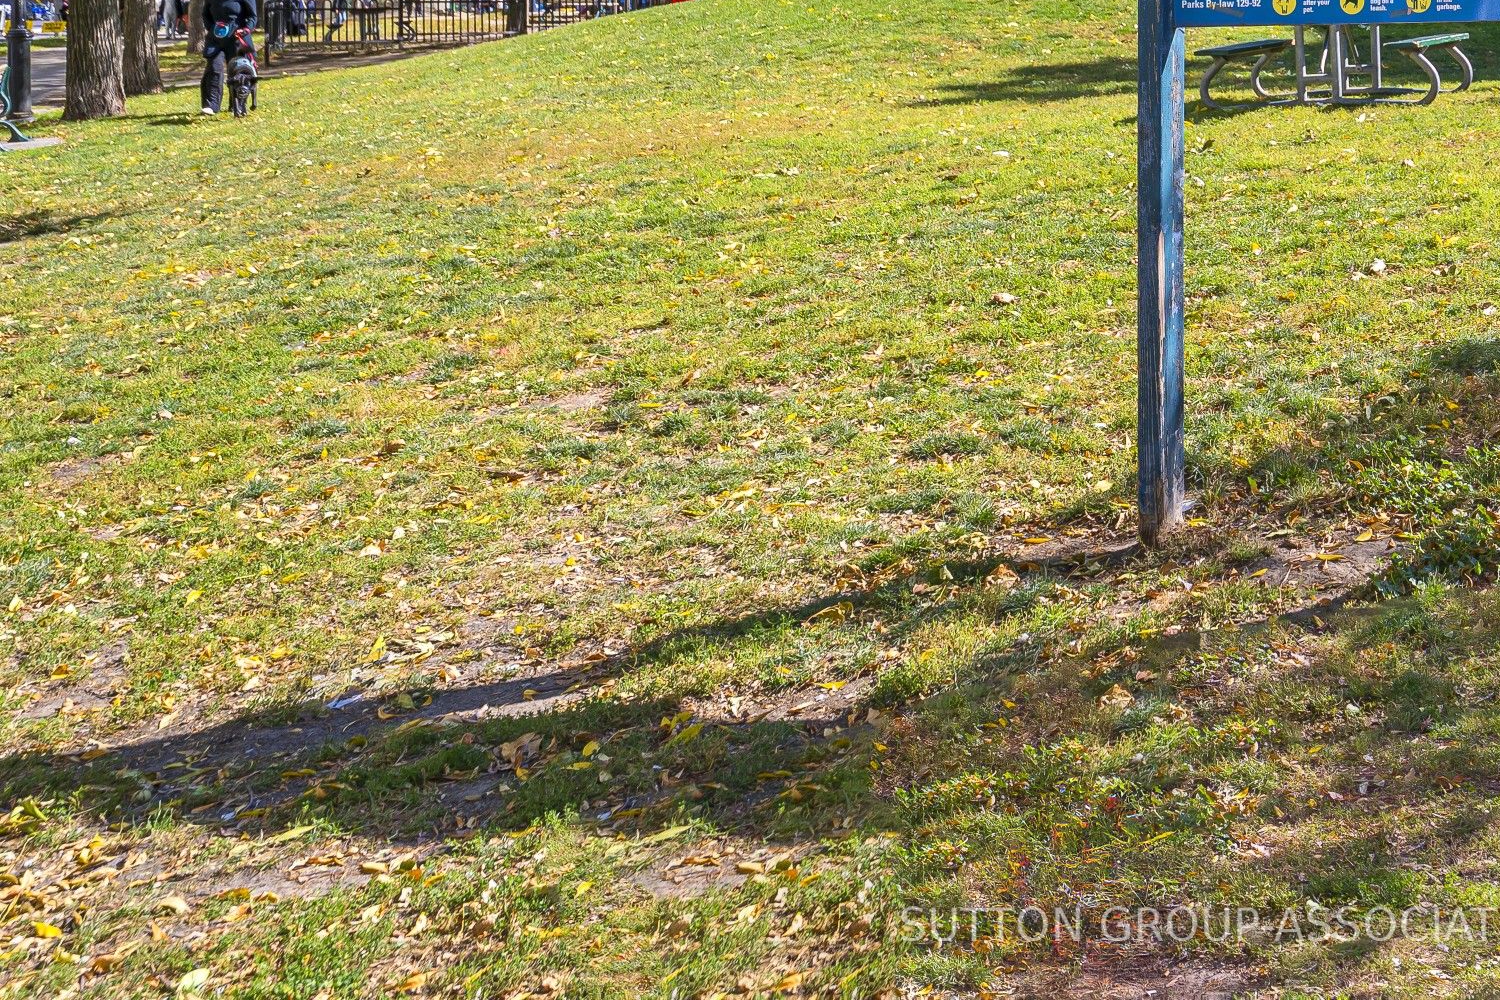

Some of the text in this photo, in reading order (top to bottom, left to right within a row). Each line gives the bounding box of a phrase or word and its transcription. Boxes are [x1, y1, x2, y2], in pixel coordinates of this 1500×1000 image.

[1181, 0, 1205, 9] Parks
[1205, 0, 1235, 10] By-law
[1436, 3, 1462, 11] garbage.
